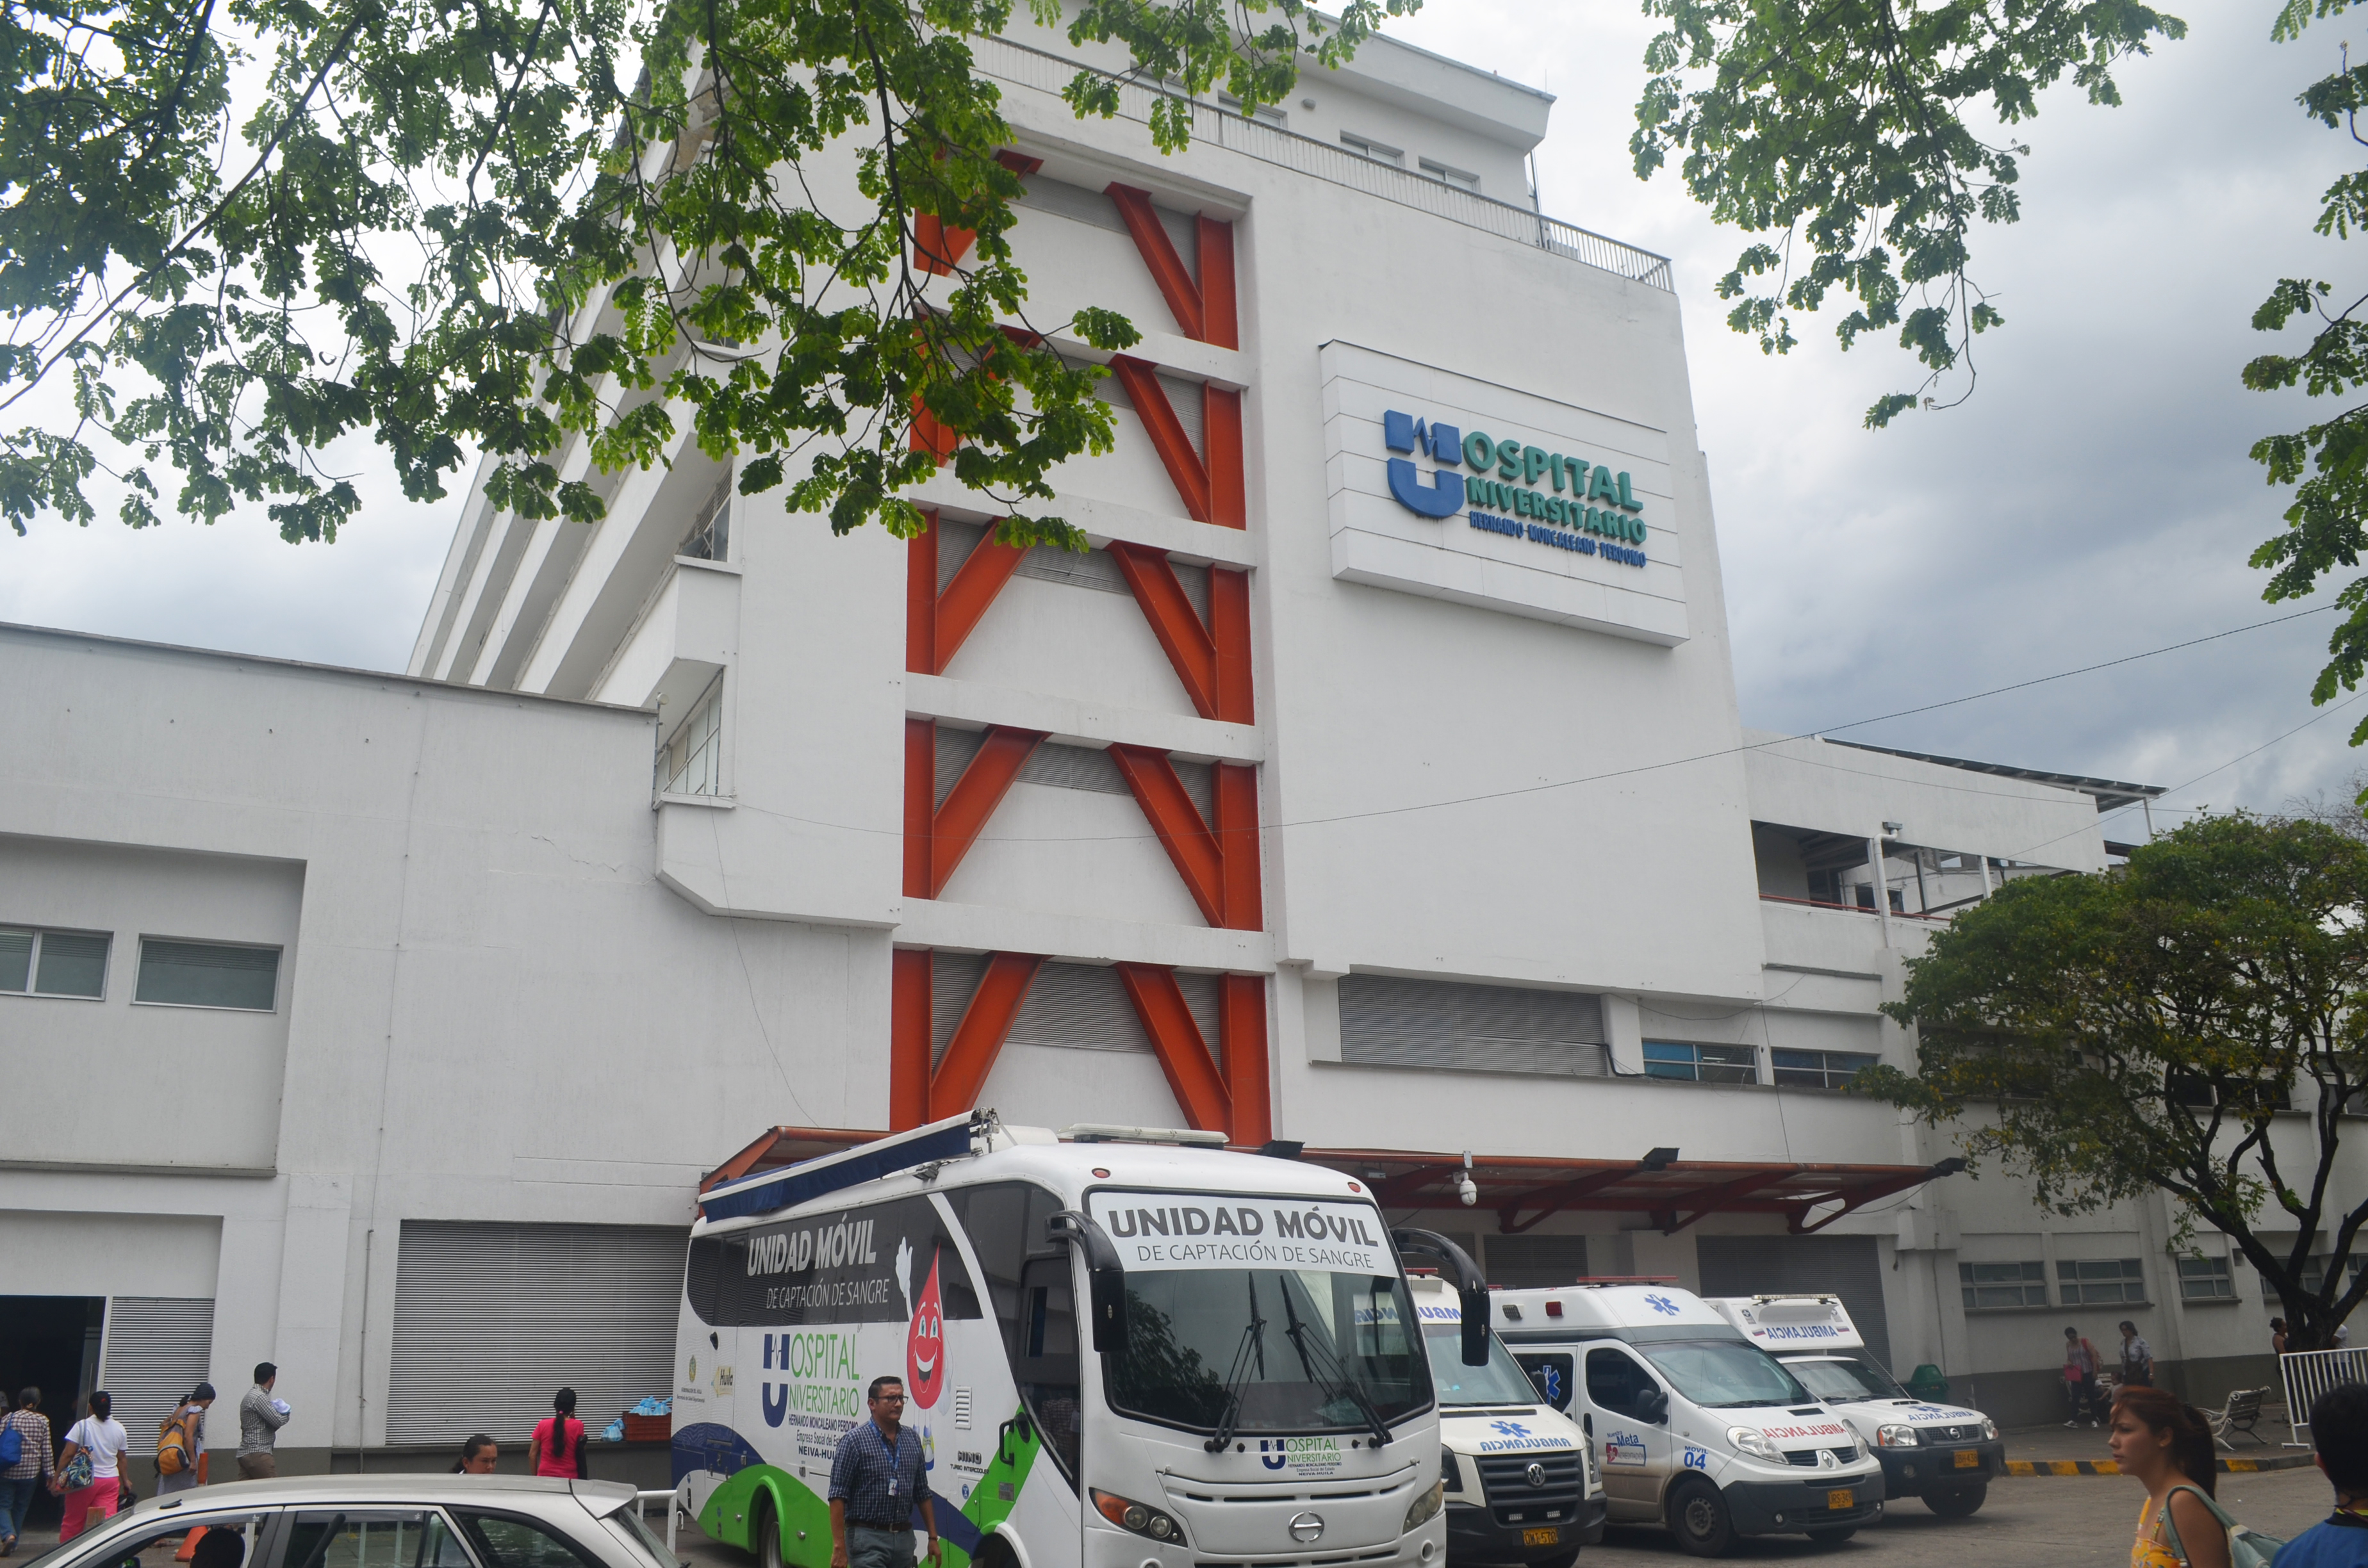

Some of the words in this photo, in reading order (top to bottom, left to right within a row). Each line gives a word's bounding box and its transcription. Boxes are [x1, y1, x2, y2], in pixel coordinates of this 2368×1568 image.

[1469, 510, 1524, 538] HERNANDO
[1527, 524, 1596, 555] MONCALEANO
[1599, 542, 1647, 568] PERDOMO
[1108, 1207, 1264, 1238] UNIDAD
[1273, 1205, 1379, 1247] MÓVIL
[747, 1230, 812, 1276] UNIDAD
[814, 1211, 876, 1270] MÓVIL
[1137, 1245, 1165, 1261] DE
[1169, 1239, 1277, 1261] CAPTACIÓN
[1282, 1246, 1306, 1262] DE
[1311, 1248, 1374, 1268] SANGRE
[766, 1288, 778, 1309] DE
[779, 1278, 830, 1309] CAPTACIÓN
[832, 1283, 845, 1306] DE
[846, 1279, 889, 1305] SANGRE
[789, 1414, 809, 1428] HERNANDO
[809, 1416, 837, 1431] MONCALEANO
[838, 1419, 859, 1432] PERDOMO
[797, 1429, 813, 1444] Empresa
[814, 1432, 826, 1445] Social
[1616, 1434, 1640, 1447] Meta
[957, 1450, 982, 1465] HINO
[1684, 1446, 1709, 1454] MOVIL
[1684, 1451, 1706, 1470] 04
[963, 1466, 989, 1474] INTERCOOLER
